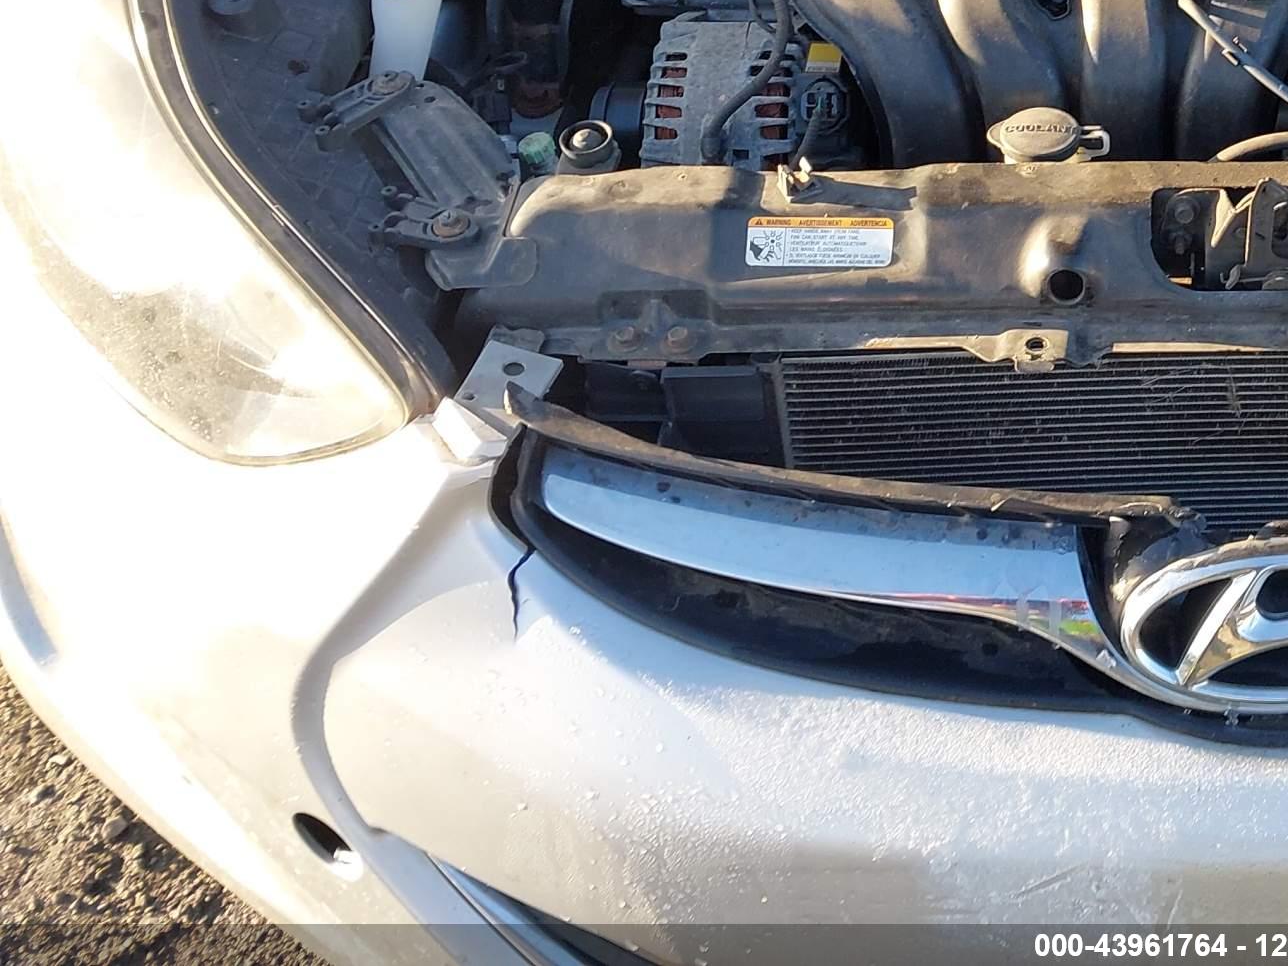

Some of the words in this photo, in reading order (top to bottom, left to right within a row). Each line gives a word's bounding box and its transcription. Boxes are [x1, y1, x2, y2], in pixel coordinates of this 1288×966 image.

[1005, 124, 1076, 135] COOLANT
[766, 218, 792, 226] WARNING
[799, 219, 842, 227] AVERTISSEMENT
[850, 219, 888, 227] ADVERTENCIA
